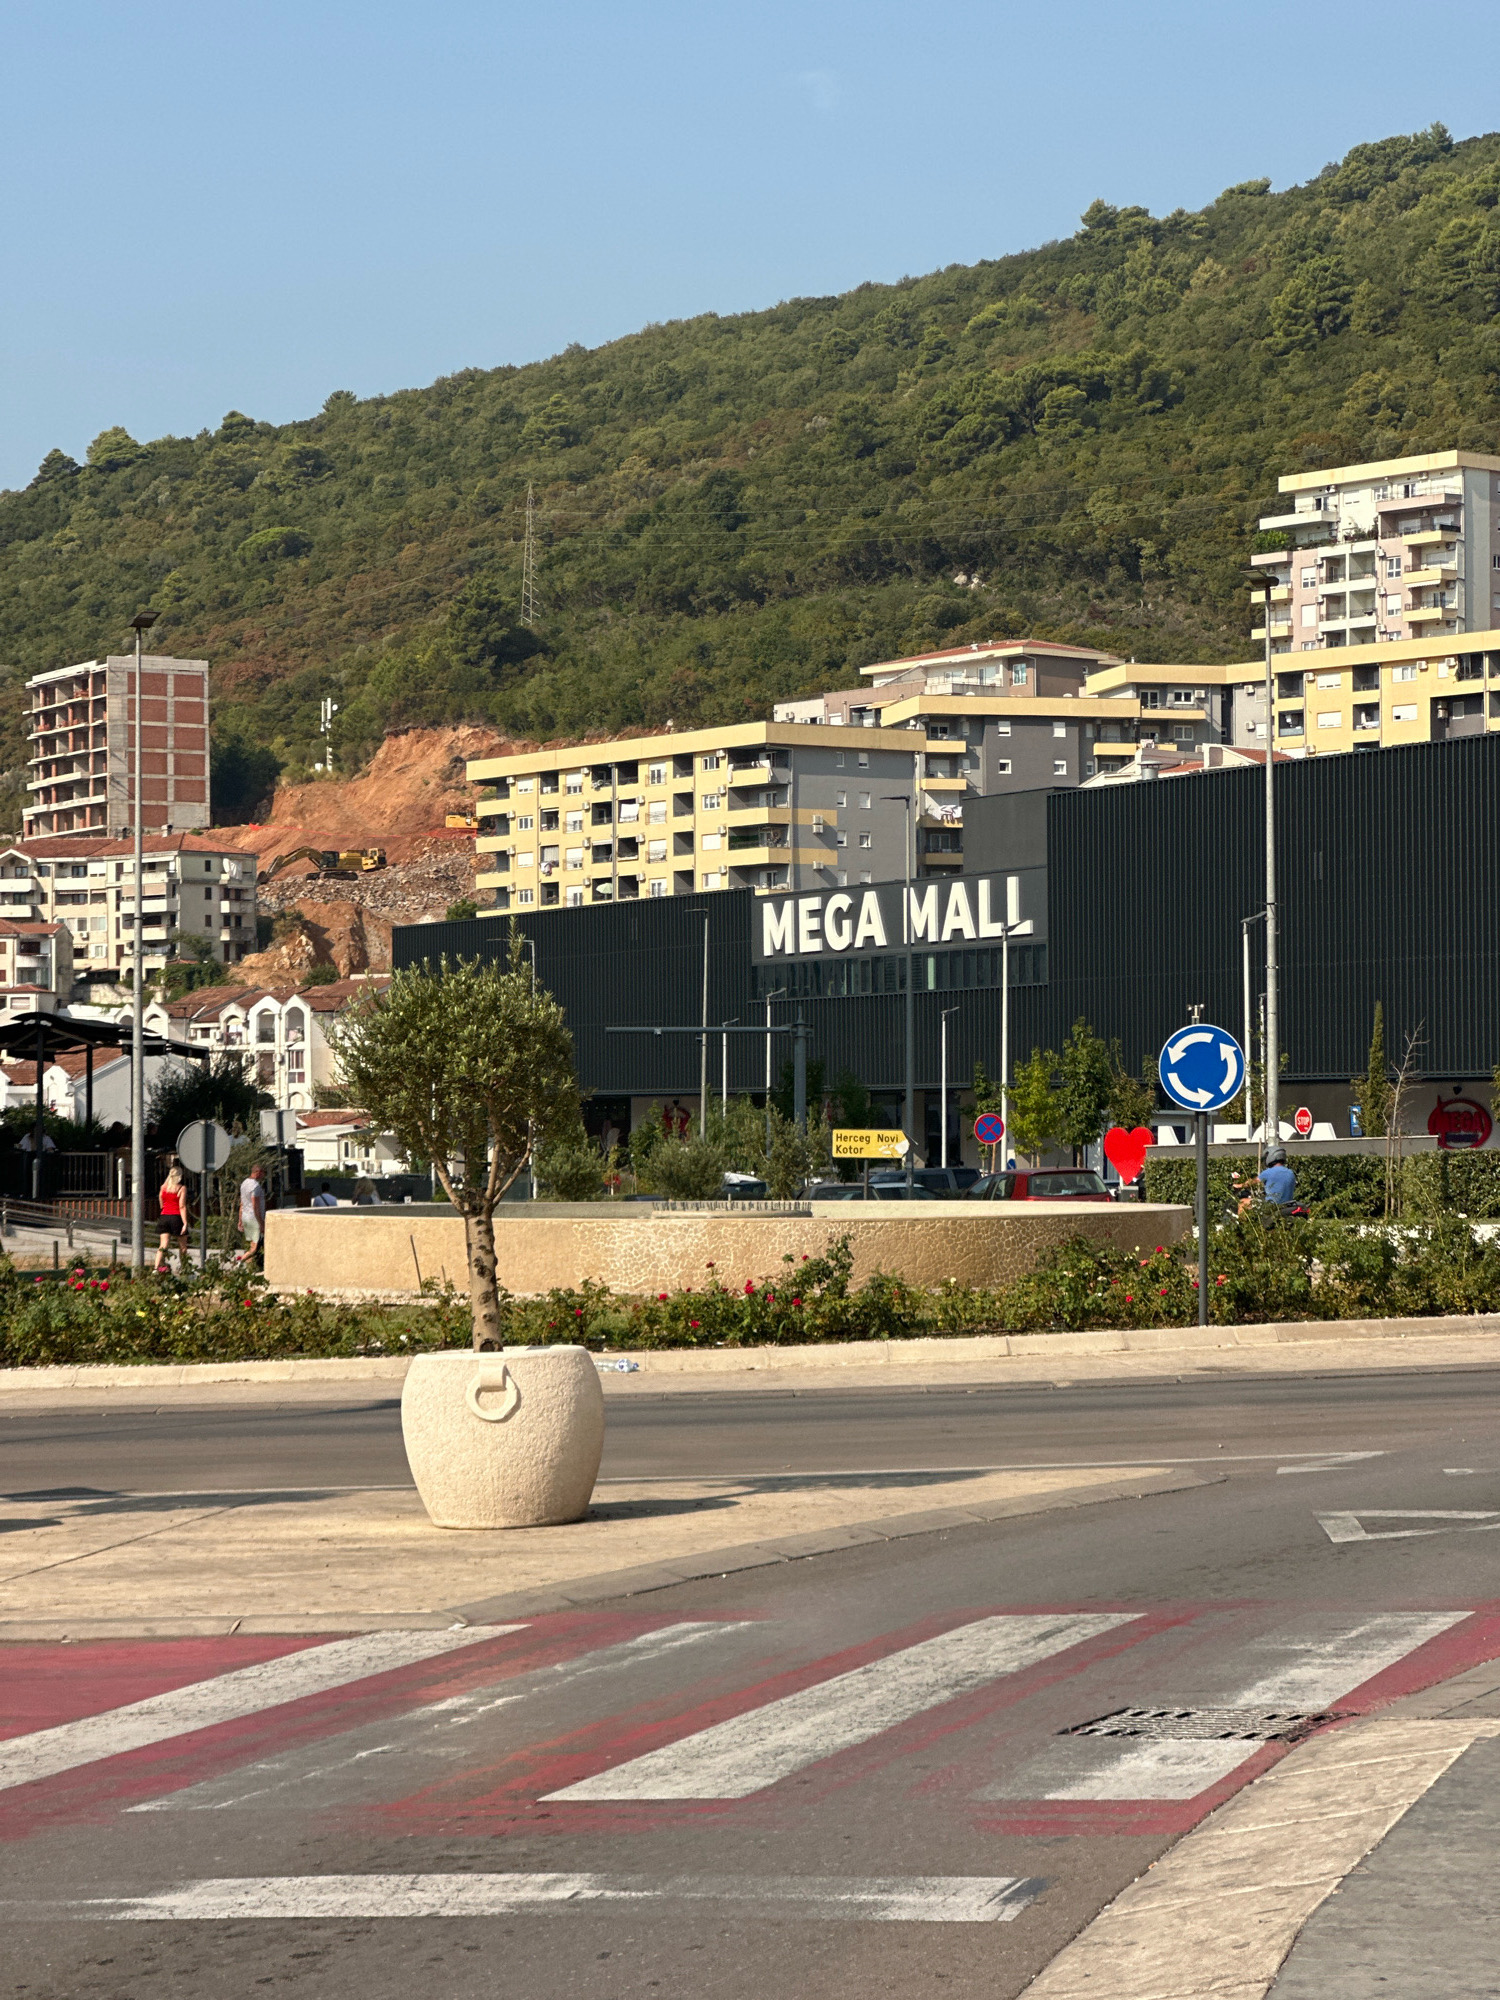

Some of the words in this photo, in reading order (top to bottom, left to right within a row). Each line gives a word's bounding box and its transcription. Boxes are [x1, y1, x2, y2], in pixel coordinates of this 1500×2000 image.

[762, 890, 887, 957] MEGA
[903, 876, 1034, 945] MALL
[1297, 1116, 1310, 1126] STOP
[836, 1133, 871, 1144] Herceg
[877, 1133, 899, 1143] Novi
[835, 1145, 864, 1154] Kotor
